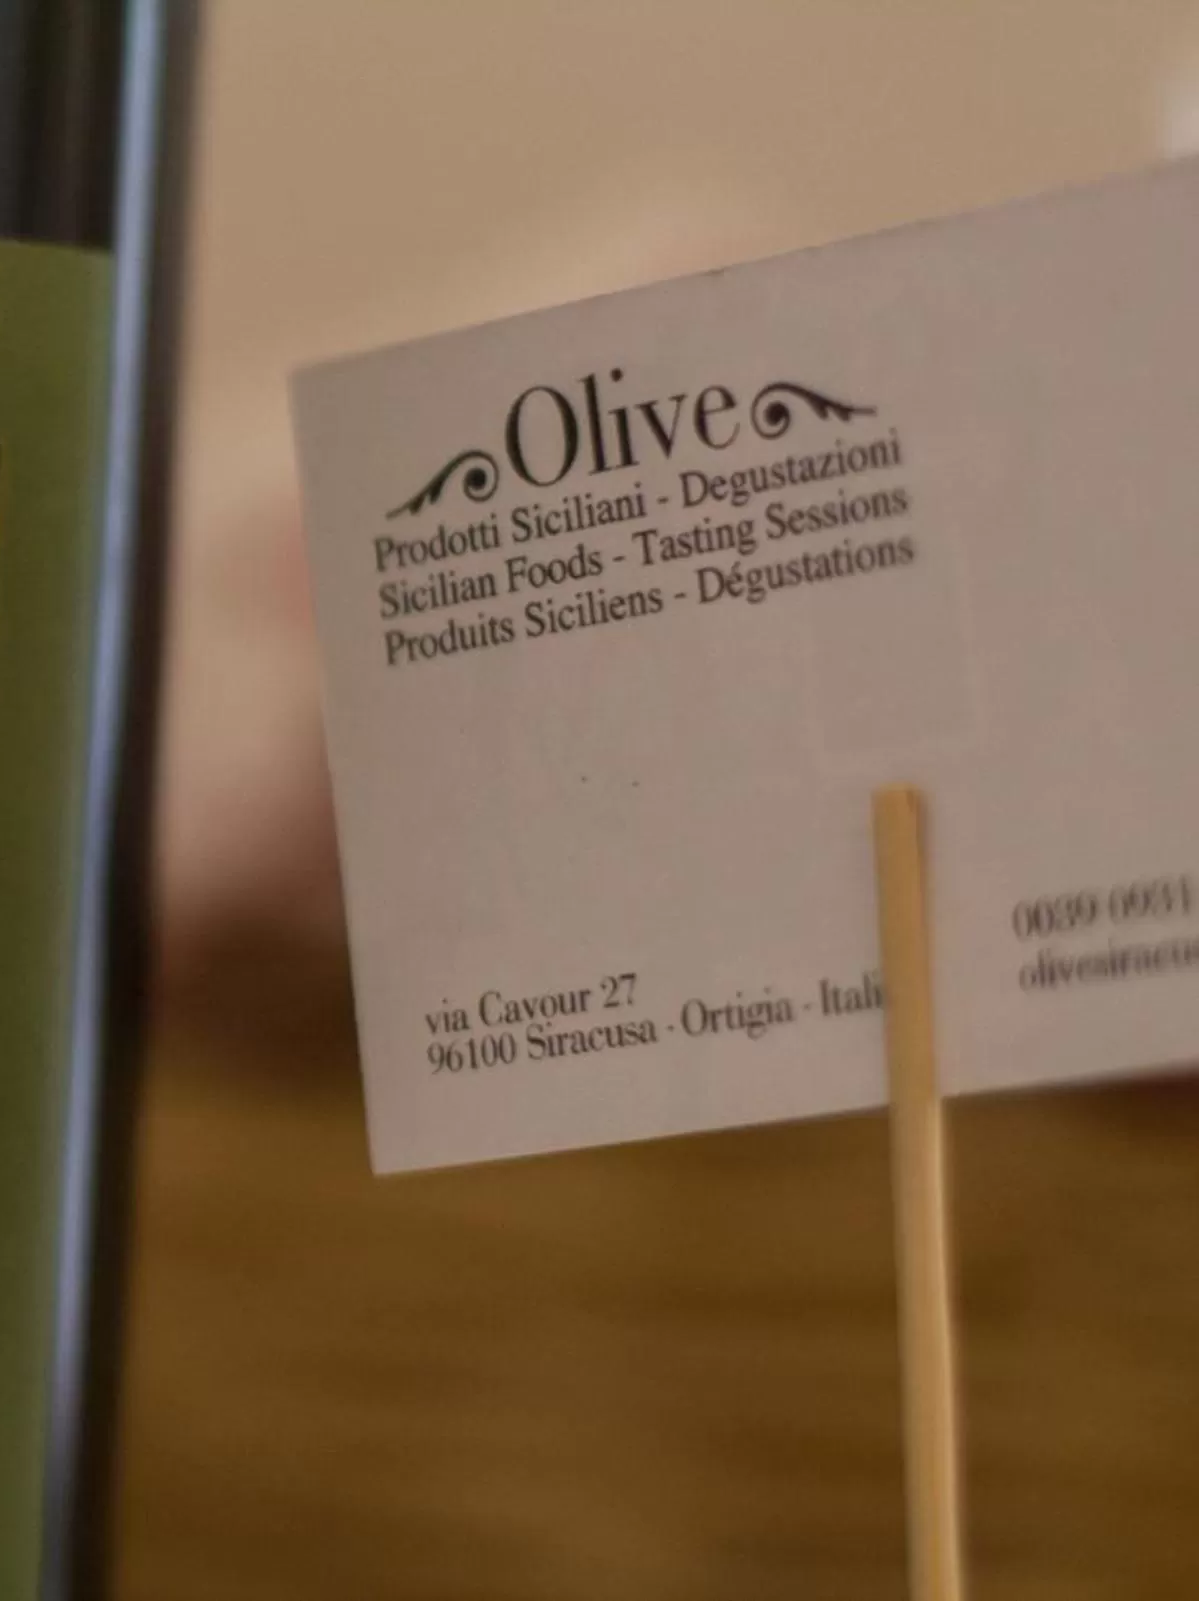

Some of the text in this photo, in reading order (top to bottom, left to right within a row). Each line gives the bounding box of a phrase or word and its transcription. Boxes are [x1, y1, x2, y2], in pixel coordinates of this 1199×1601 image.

[503, 366, 741, 489] Olive
[373, 511, 503, 574] Prodotti
[510, 480, 649, 546] Siciliani
[678, 425, 903, 508] Degustazioni
[378, 569, 499, 621] Sicilian
[505, 542, 604, 594] Foods
[632, 516, 758, 567] Tasting
[764, 487, 909, 542] Sessions
[384, 611, 517, 667] Produits
[524, 588, 664, 640] Siciliens
[694, 534, 917, 606] Dégustations
[424, 971, 639, 1036] via Cavour 27
[426, 1030, 519, 1076] 96100
[525, 1018, 660, 1061] Siracusa
[680, 984, 796, 1042] Ortigia
[818, 969, 885, 1017] Itali
